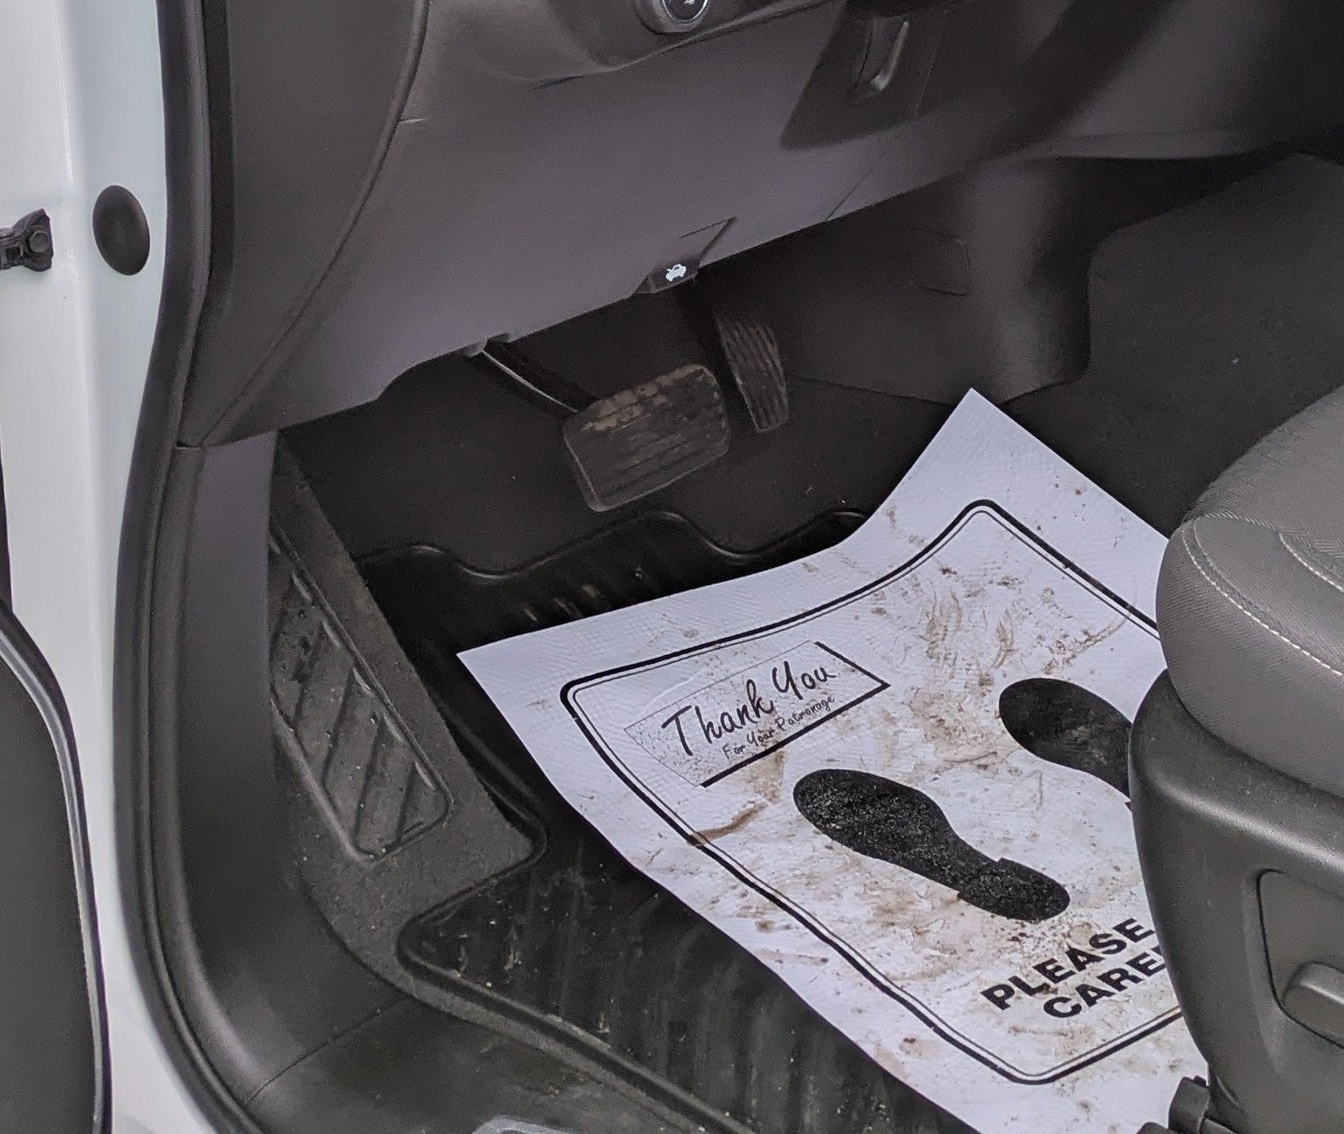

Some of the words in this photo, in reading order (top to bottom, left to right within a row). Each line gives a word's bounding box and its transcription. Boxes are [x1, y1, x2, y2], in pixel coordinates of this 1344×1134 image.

[661, 679, 775, 756] Thank
[772, 660, 837, 701] You
[722, 743, 746, 760] For
[747, 726, 776, 747] Your
[775, 695, 836, 732] Patronage
[980, 918, 1157, 1011] PLEASE
[1043, 945, 1167, 1018] CARE
